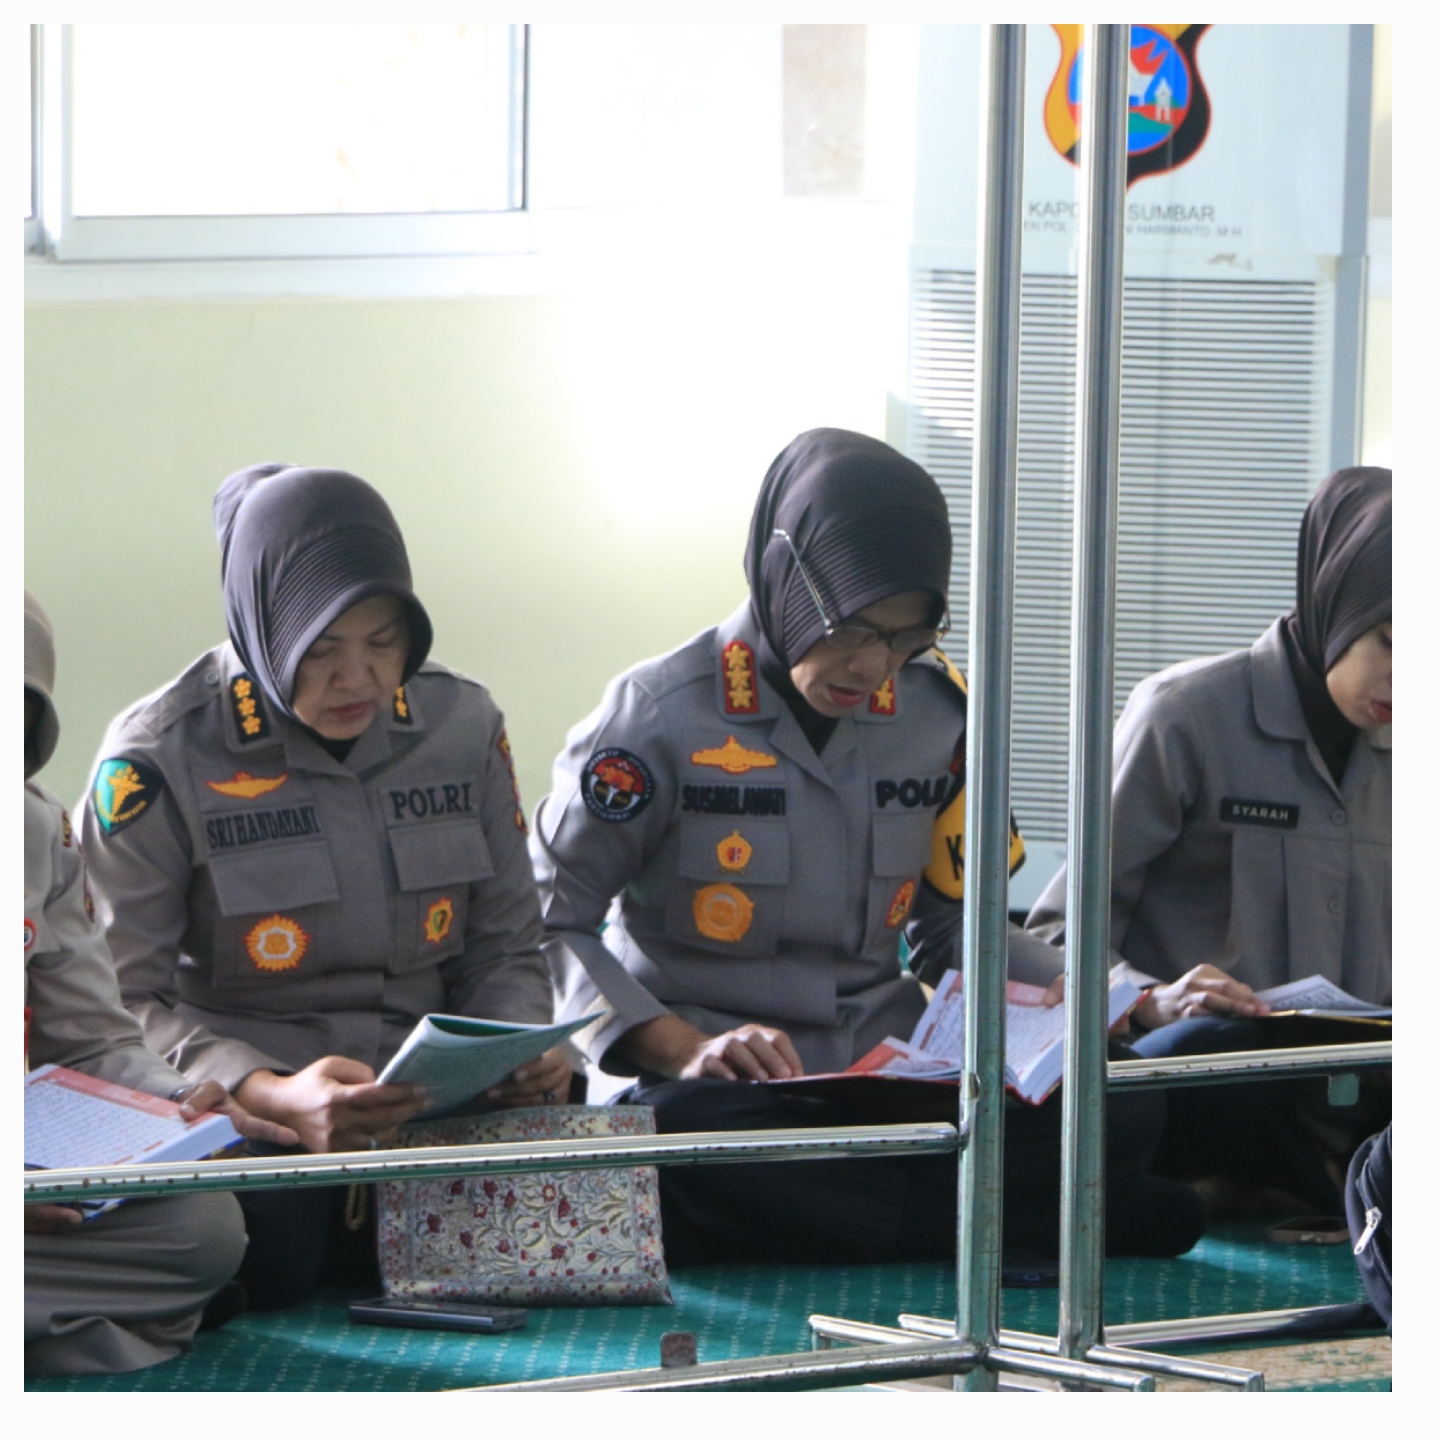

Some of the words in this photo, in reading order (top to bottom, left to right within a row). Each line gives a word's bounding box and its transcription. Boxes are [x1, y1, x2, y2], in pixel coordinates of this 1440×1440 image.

[1127, 203, 1216, 223] SUMBAR
[389, 783, 474, 820] POLRI
[1232, 803, 1289, 821] SYARAH
